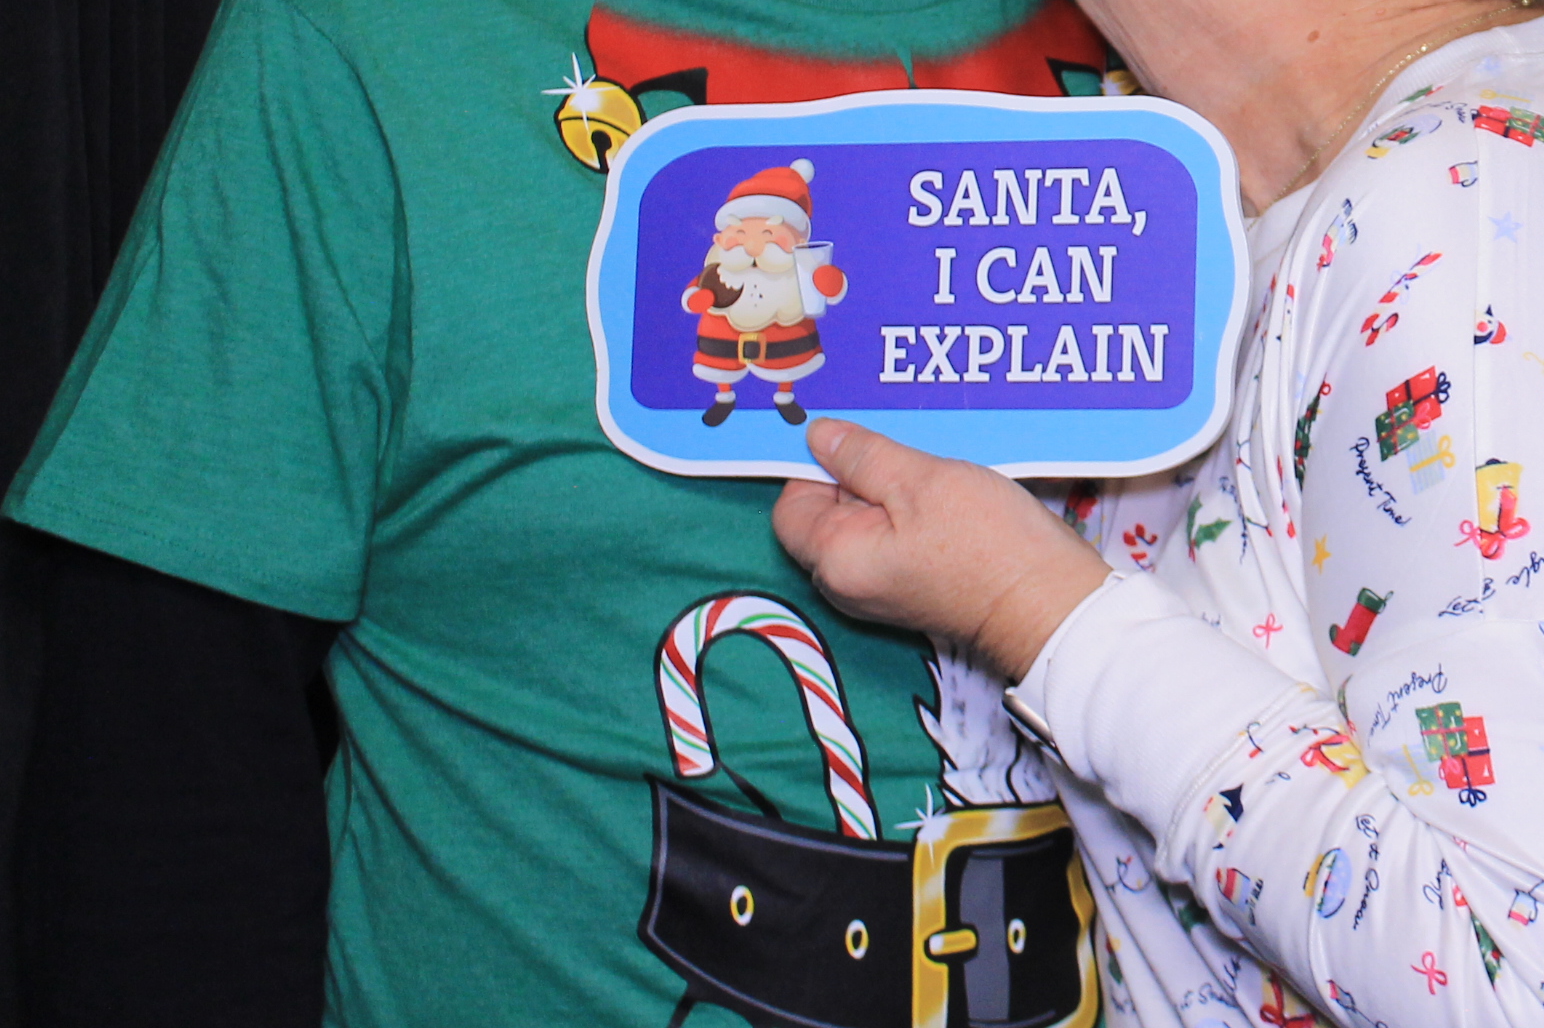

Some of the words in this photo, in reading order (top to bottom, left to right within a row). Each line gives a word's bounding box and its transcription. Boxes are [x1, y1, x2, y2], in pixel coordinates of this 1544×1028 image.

[907, 167, 1148, 236] SANTA,
[933, 247, 955, 304] I
[976, 246, 1117, 304] CAN
[879, 324, 1169, 383] EXPLAIN
[1348, 436, 1391, 497] Present
[1389, 663, 1447, 712] Present
